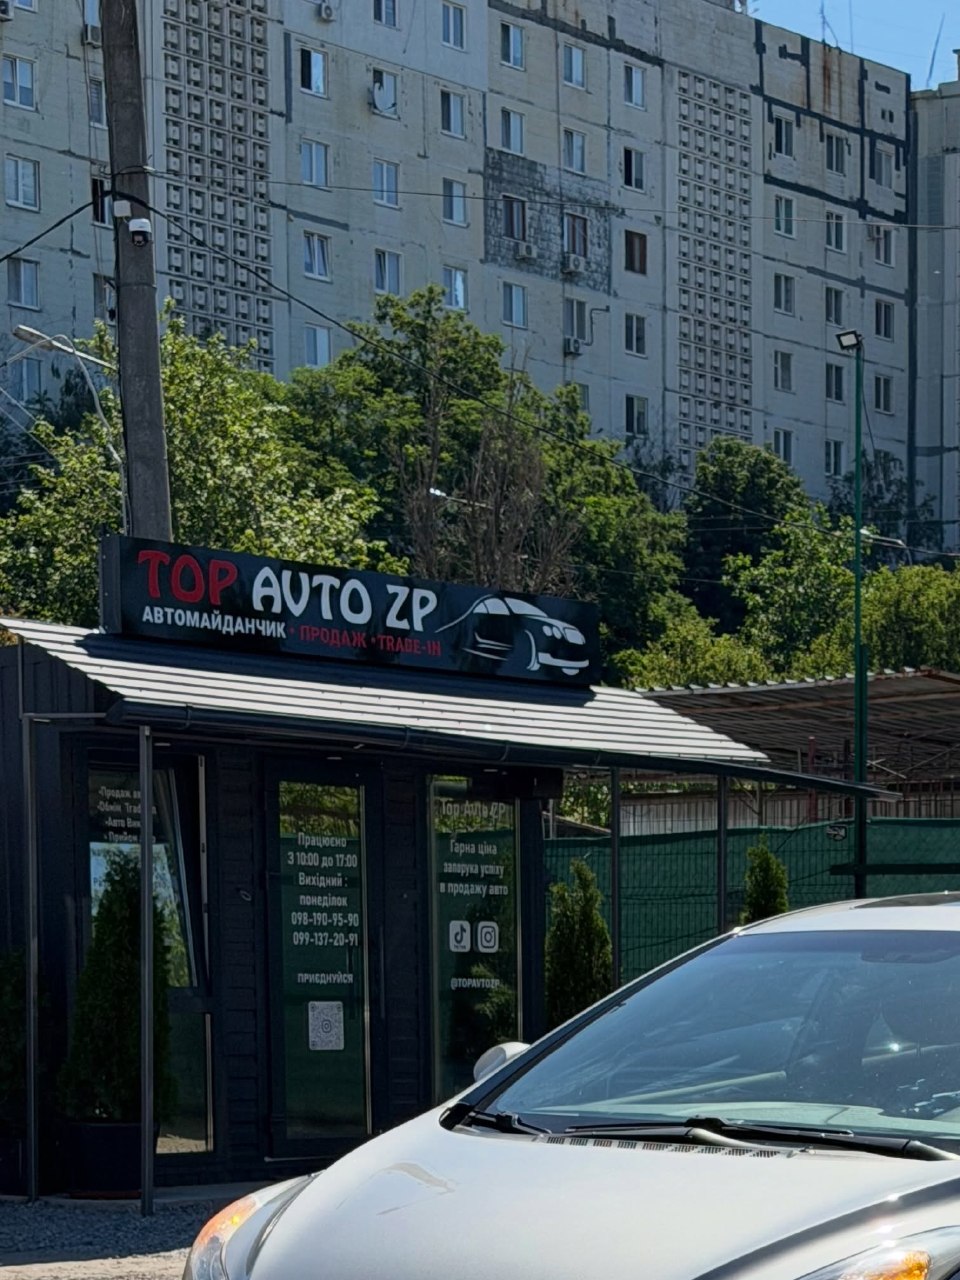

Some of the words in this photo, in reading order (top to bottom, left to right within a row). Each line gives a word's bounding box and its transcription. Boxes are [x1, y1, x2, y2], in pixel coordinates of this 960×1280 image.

[137, 549, 238, 606] TOP
[252, 566, 373, 625] AVTO
[386, 583, 438, 632] ZP
[142, 605, 287, 639] АВТОМАЙДАНЧИК
[299, 625, 367, 649] ПРОДАЖ
[297, 832, 347, 849] Працюємо
[297, 852, 320, 867] 10:00
[321, 856, 334, 868] до
[336, 854, 358, 868] 17:00
[298, 872, 344, 888] Вихідний
[299, 893, 348, 908] понеділок
[291, 912, 360, 928] 098-190-95-90
[292, 931, 358, 947] 099-137-20-91
[297, 971, 354, 985] ПРИЄДНУЙСЯ
